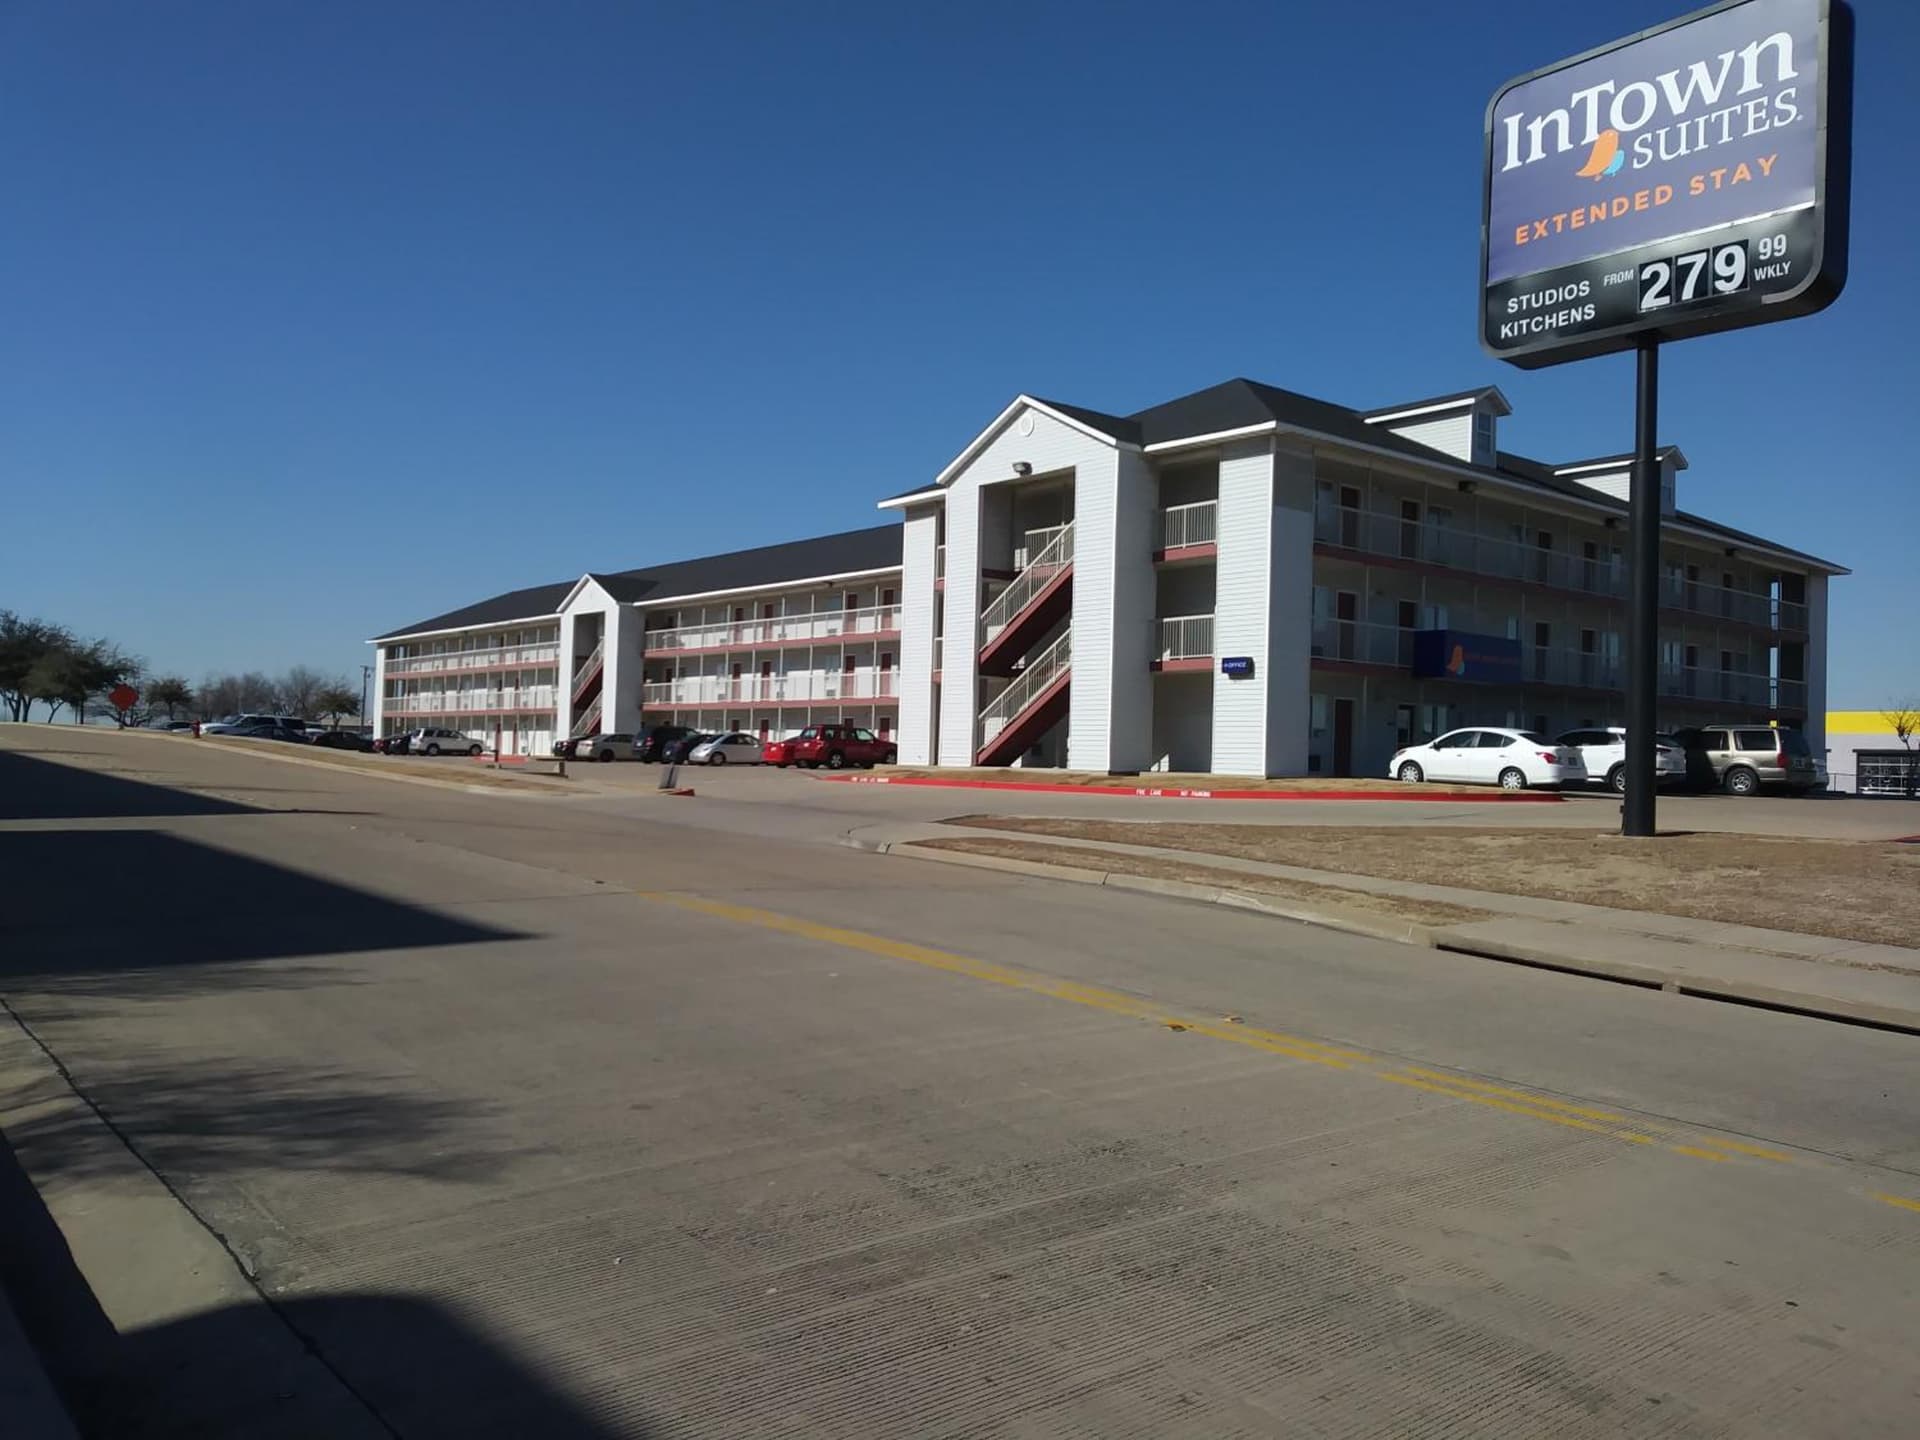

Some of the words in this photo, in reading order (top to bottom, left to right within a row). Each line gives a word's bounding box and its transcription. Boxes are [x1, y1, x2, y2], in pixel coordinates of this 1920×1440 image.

[1502, 31, 1799, 172] InTown
[1633, 88, 1799, 168] SUITES
[1515, 185, 1673, 246] EXTENDED
[1689, 154, 1779, 196] STAY
[1506, 280, 1591, 314] STUDIOS
[1603, 268, 1635, 287] FROM
[1639, 244, 1747, 310] 279
[1758, 234, 1788, 260] 99
[1754, 261, 1792, 281] WKLY
[1500, 303, 1597, 339] KITCHENS
